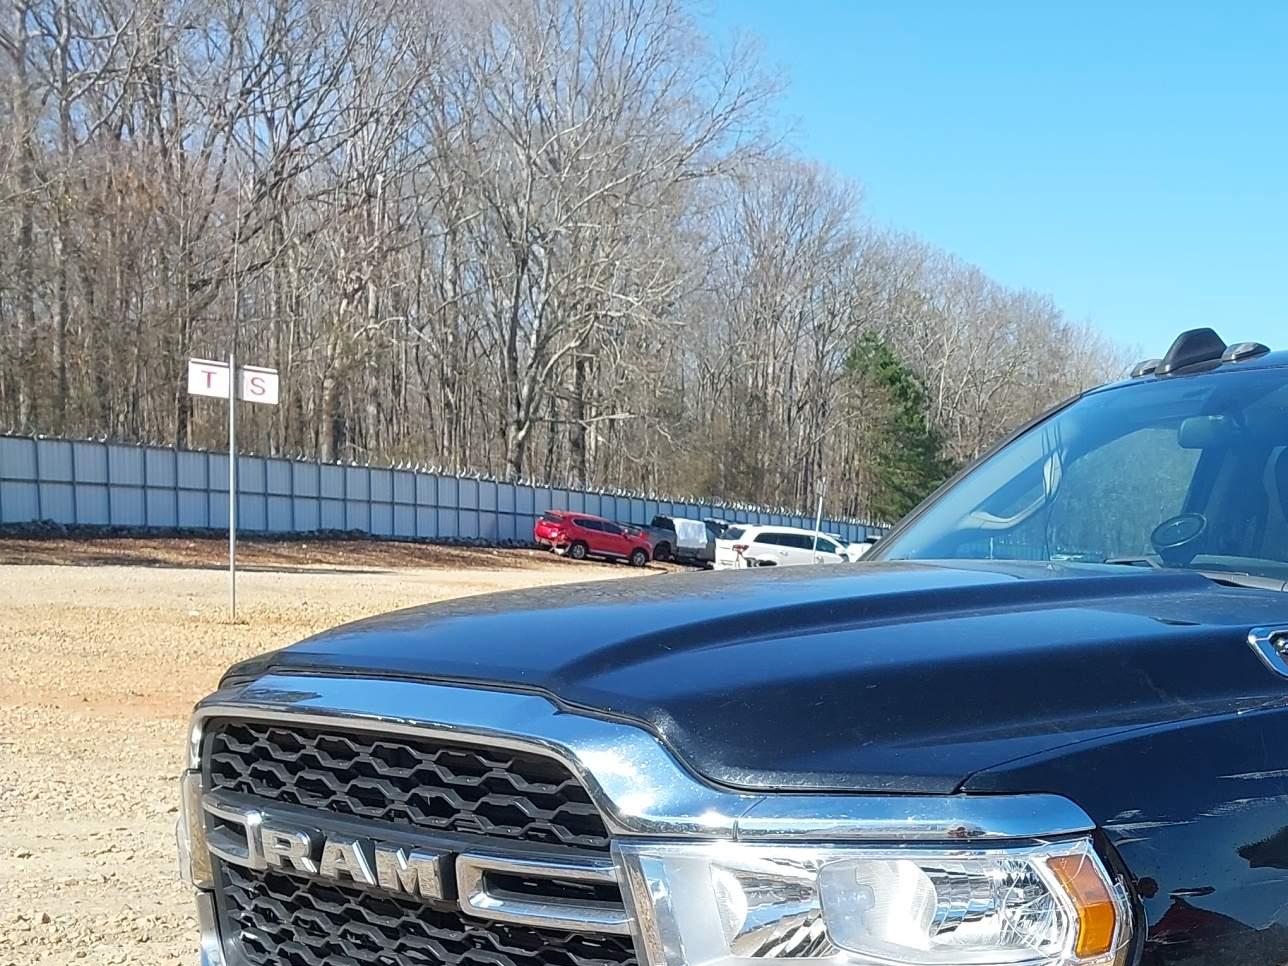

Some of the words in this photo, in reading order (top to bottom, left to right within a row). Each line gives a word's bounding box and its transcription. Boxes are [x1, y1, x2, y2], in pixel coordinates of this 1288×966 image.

[201, 370, 217, 388] T
[250, 377, 266, 396] S
[261, 825, 447, 900] RAM
